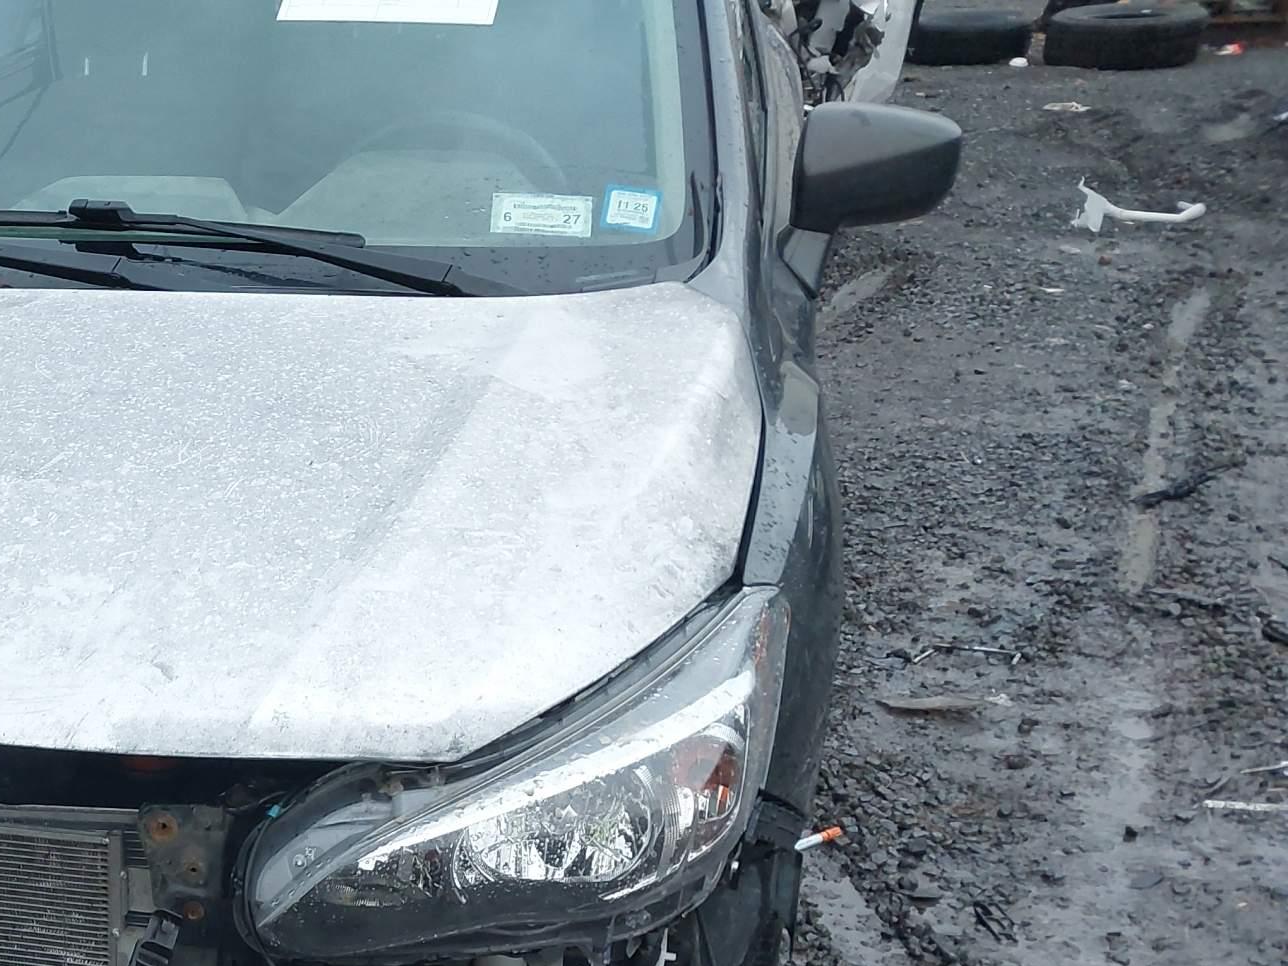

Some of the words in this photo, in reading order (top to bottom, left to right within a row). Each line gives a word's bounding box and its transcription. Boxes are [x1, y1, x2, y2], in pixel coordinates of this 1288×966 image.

[633, 202, 649, 213] 25
[503, 211, 513, 222] 6
[562, 213, 582, 225] 27
